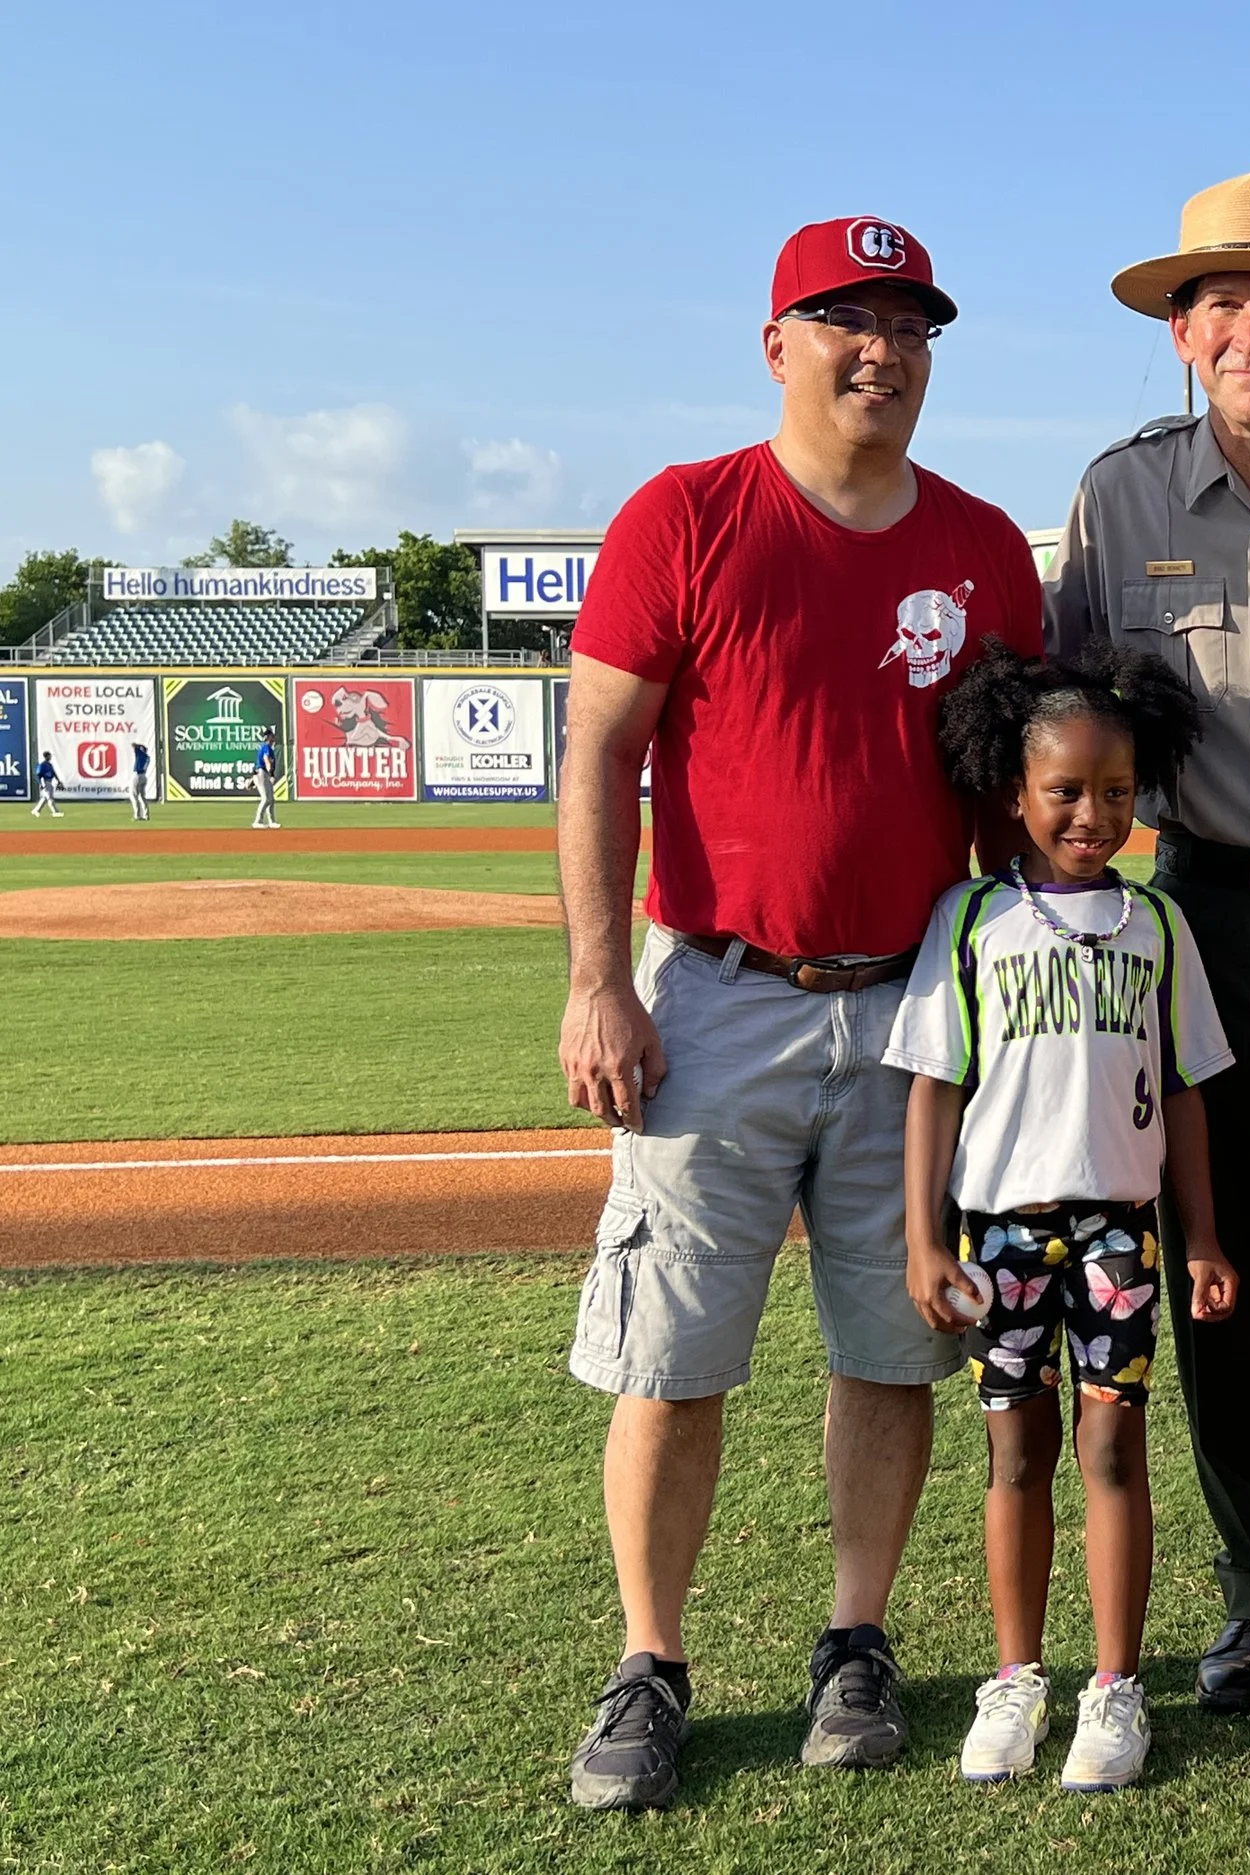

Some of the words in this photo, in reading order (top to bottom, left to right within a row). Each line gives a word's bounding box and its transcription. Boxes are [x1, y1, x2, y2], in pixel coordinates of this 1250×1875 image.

[107, 572, 167, 596] Hello
[174, 571, 366, 597] humankindness
[499, 557, 585, 602] Hell
[47, 687, 91, 698] MORE
[96, 687, 143, 698] LOCAL
[65, 704, 125, 715] STORIES
[54, 722, 100, 733] EVERY
[104, 722, 137, 733] DAY.
[176, 742, 222, 751] ADVENTIST
[226, 742, 275, 751] UNIVER
[195, 760, 234, 773] Power
[236, 760, 255, 773] for
[303, 747, 408, 778] HUNTER
[190, 776, 222, 790] Mind
[223, 776, 234, 790] &
[312, 776, 328, 788] Oil
[385, 776, 403, 789] Inc.
[433, 787, 537, 796] WHOLESALESUPPLY.US
[1081, 946, 1094, 962] 9
[1132, 1066, 1153, 1130] 9
